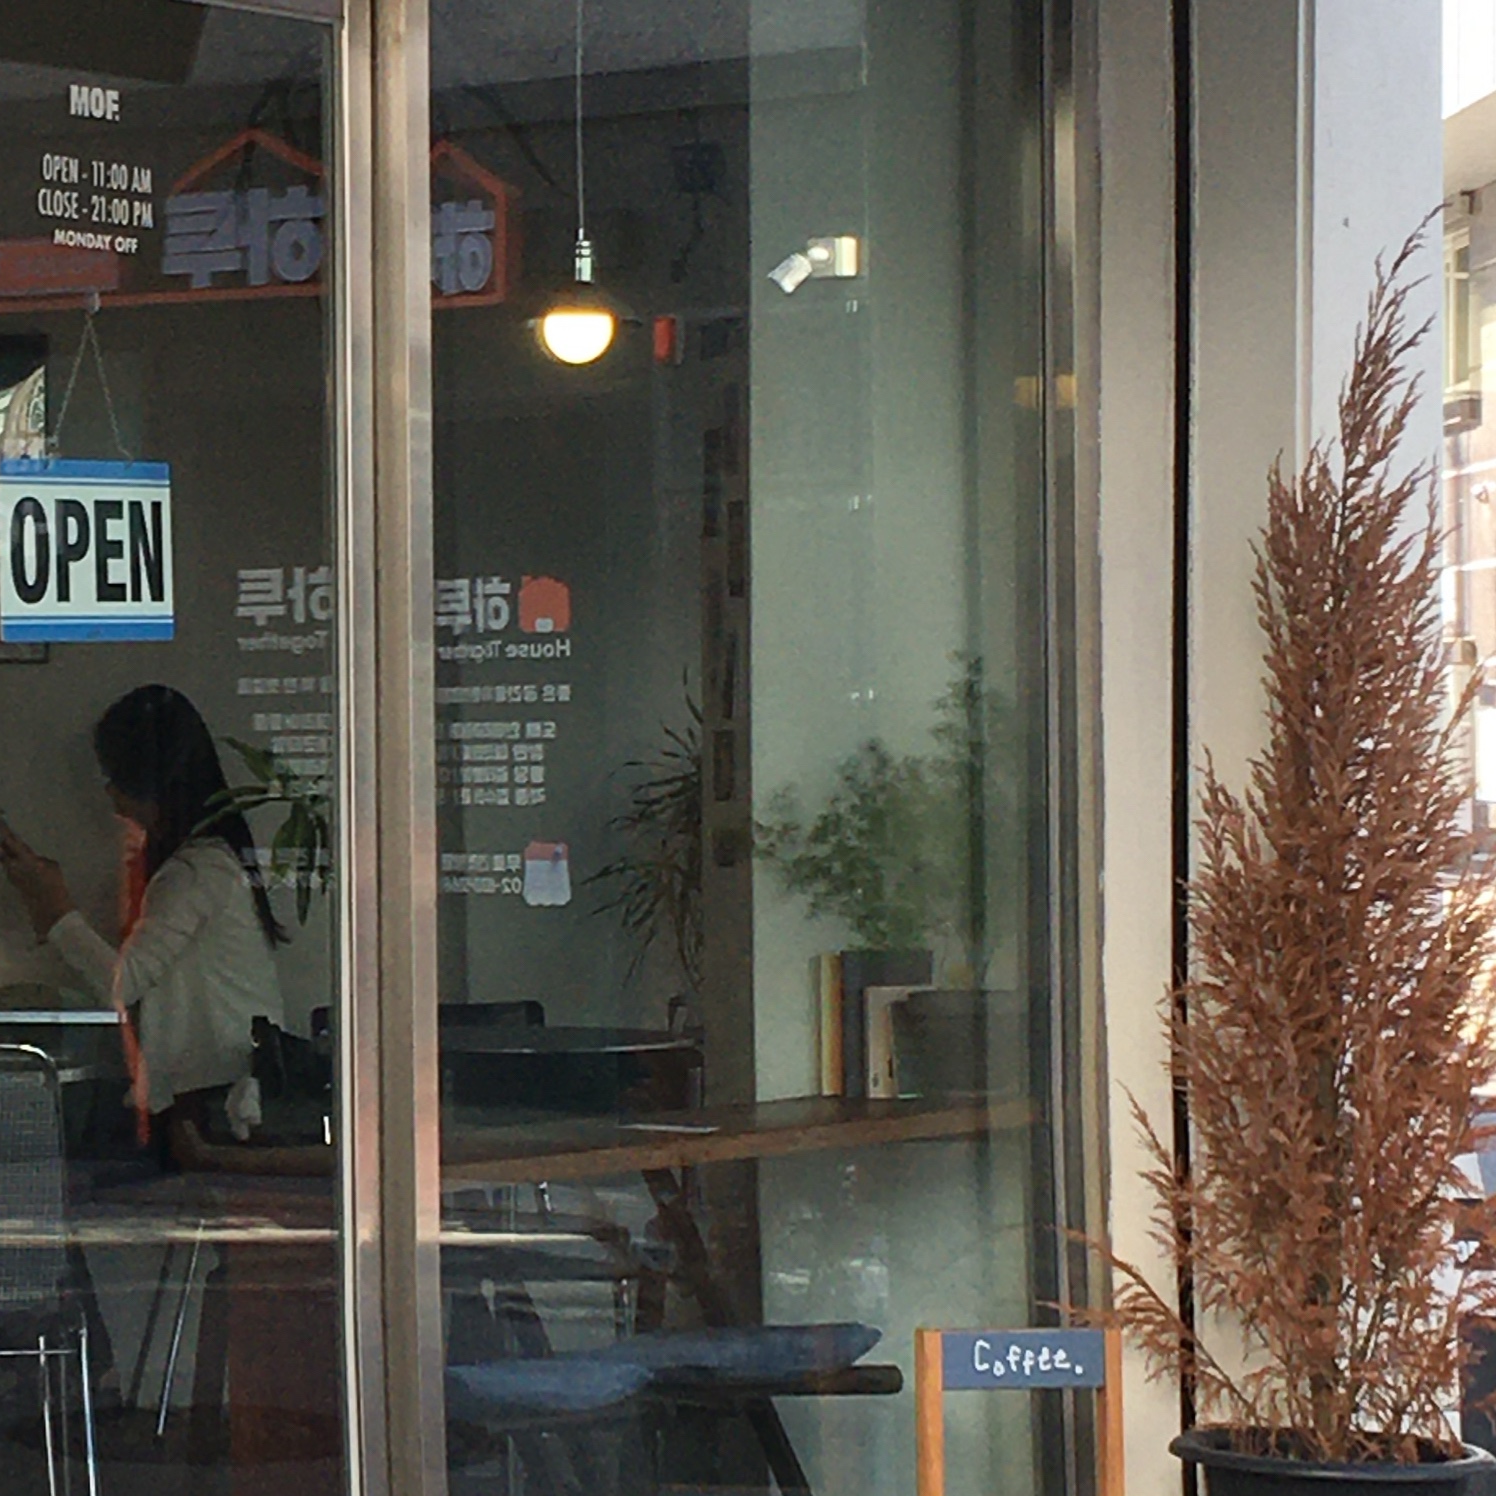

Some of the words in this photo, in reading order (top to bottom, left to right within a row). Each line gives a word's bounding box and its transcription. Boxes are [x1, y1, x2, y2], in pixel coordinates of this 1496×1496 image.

[69, 84, 120, 121] MOF.
[42, 153, 79, 184] OPEN
[91, 161, 129, 191] 11:00
[131, 166, 152, 194] AM
[38, 188, 79, 220] CLOSE
[91, 195, 129, 227] 21:00
[133, 201, 154, 229] PM
[54, 228, 111, 251] MONDAY
[114, 235, 138, 254] OFF
[10, 497, 165, 604] OPEN
[974, 1339, 1084, 1377] Coffee.
